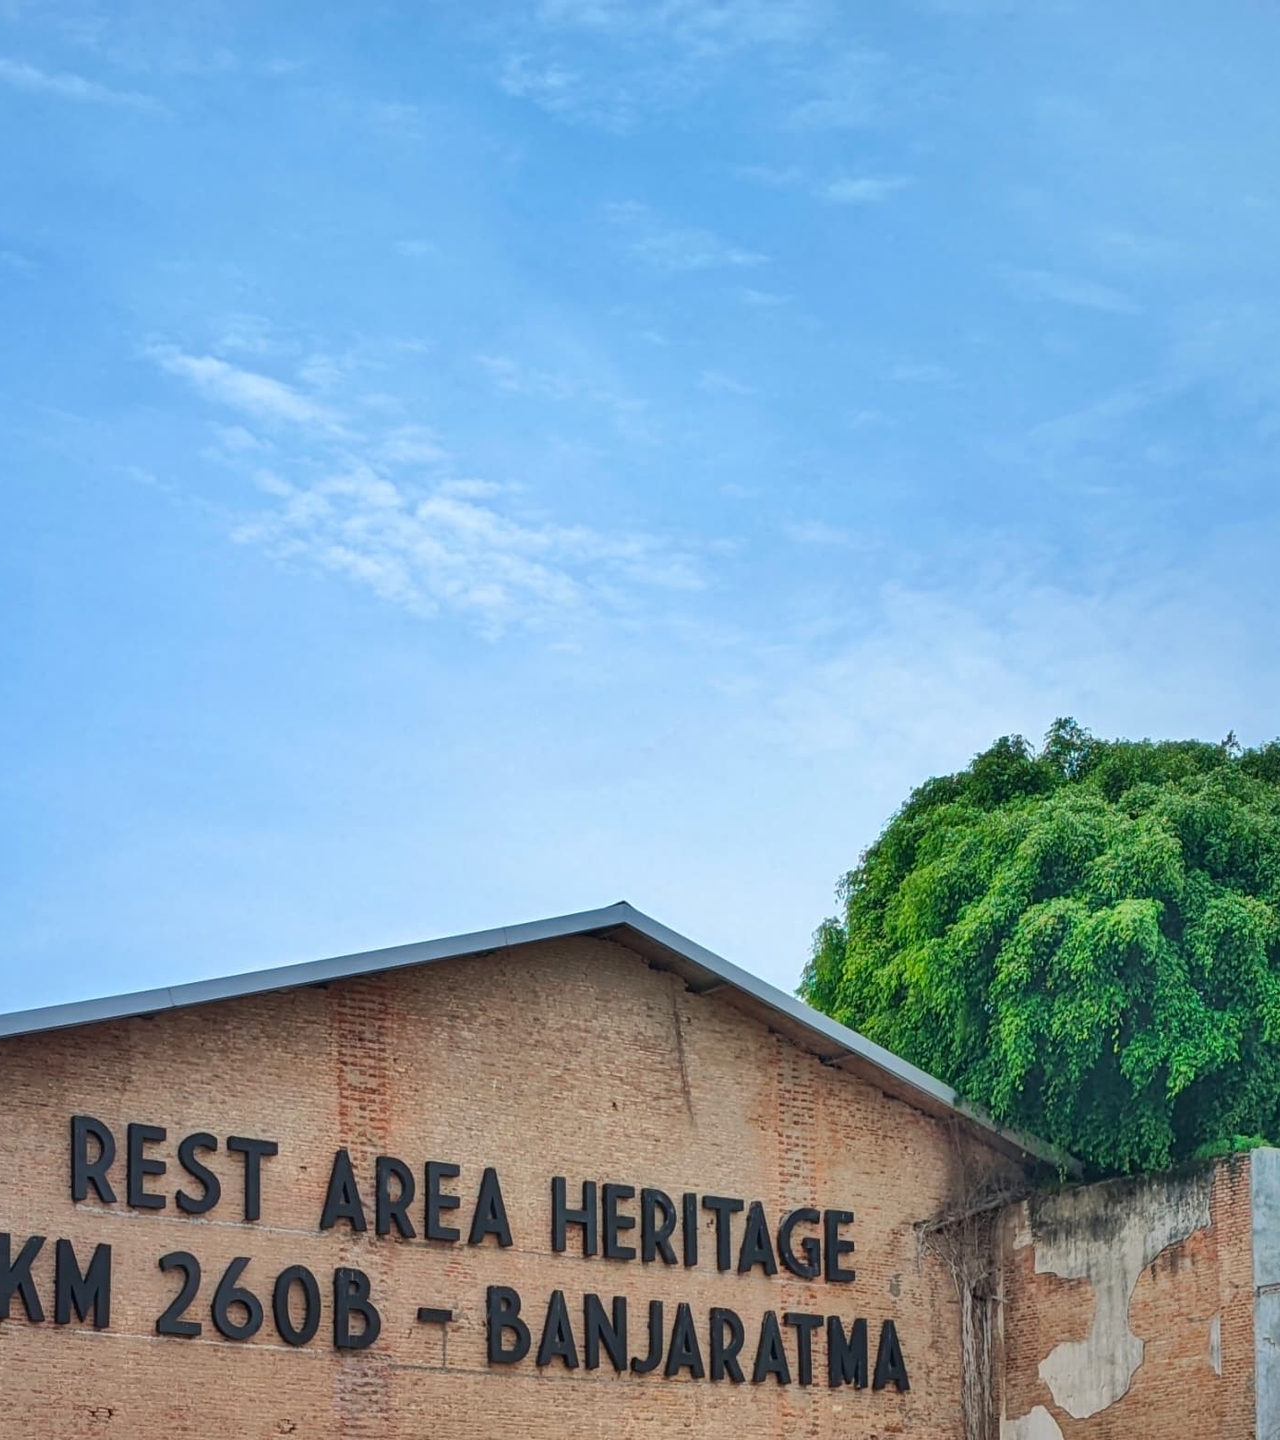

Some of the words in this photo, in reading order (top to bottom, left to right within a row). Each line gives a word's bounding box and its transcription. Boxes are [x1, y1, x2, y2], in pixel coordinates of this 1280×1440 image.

[70, 1114, 278, 1222] REST
[320, 1148, 514, 1249] AREA
[551, 1175, 856, 1284] HERITAGE
[155, 1250, 382, 1352] 260B
[485, 1284, 911, 1393] BANJARATMA
